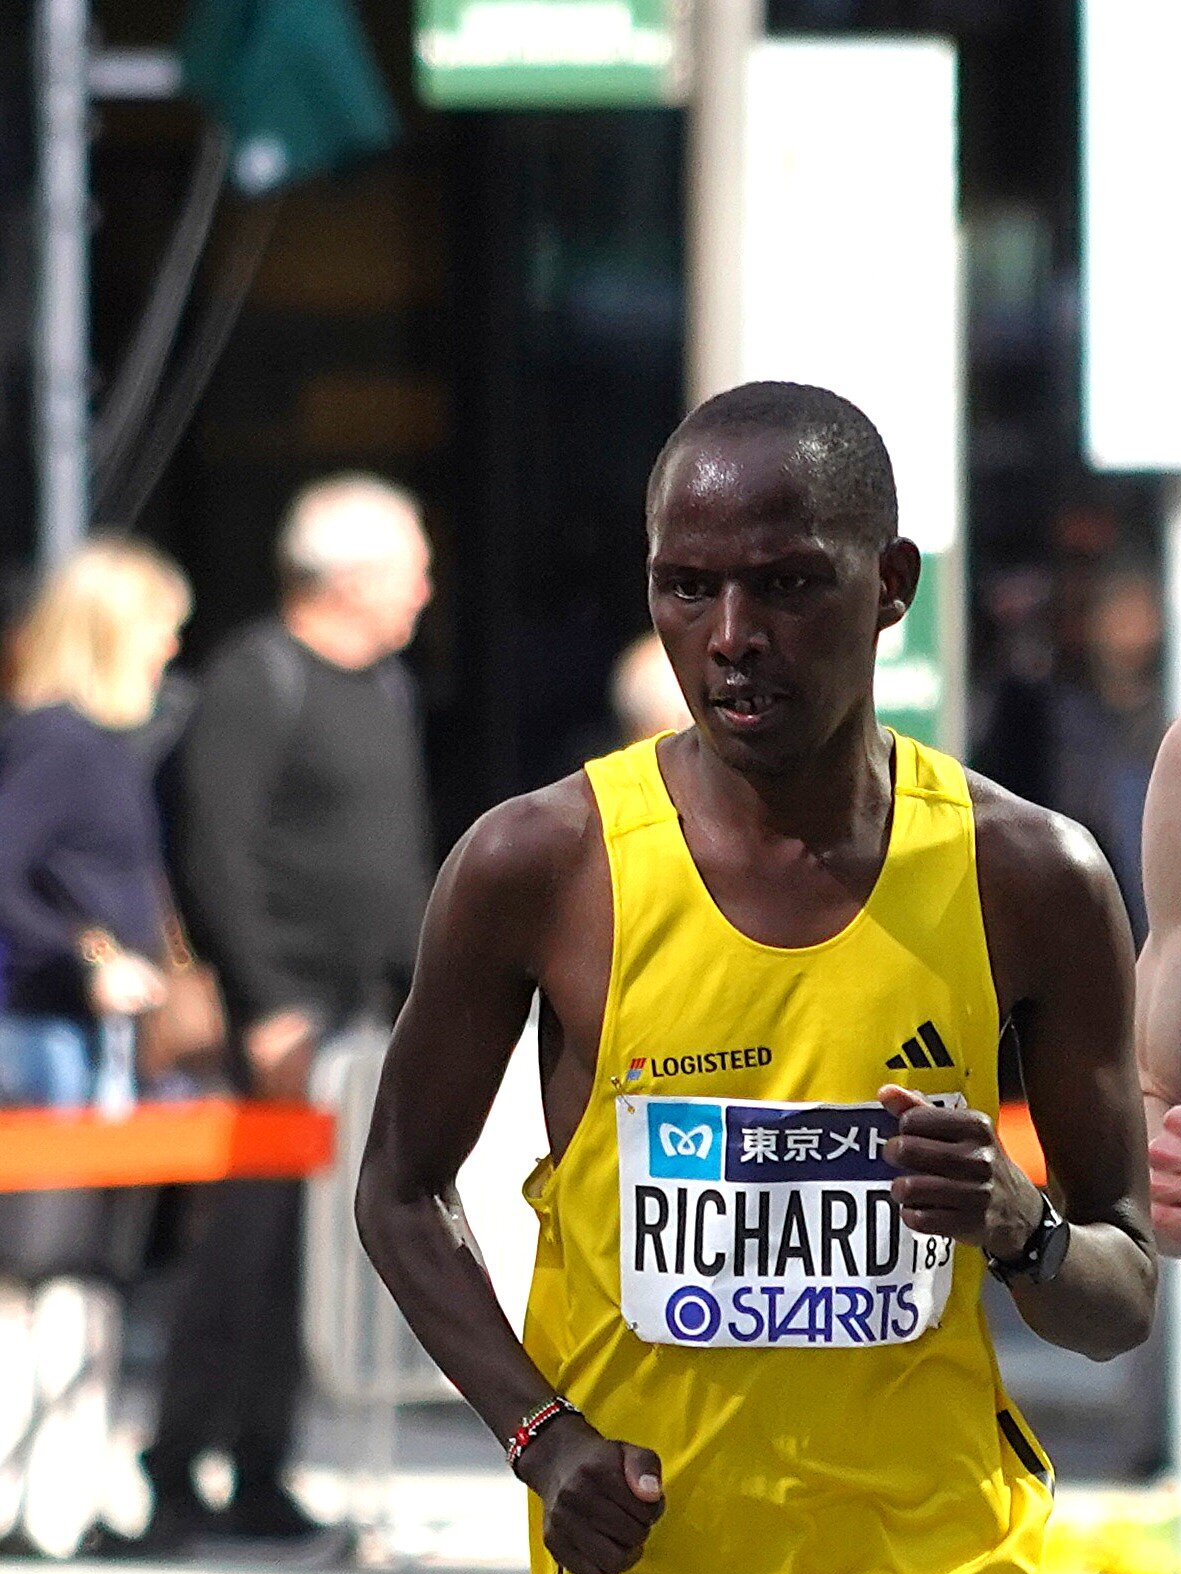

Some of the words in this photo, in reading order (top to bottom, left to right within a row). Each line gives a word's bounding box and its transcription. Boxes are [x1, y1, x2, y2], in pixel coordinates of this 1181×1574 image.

[651, 1046, 772, 1078] LOGISTEED
[740, 1126, 887, 1164] 東京メト
[634, 1184, 899, 1277] RICHARD
[912, 1237, 950, 1273] 183
[729, 1283, 919, 1342] STARTS
